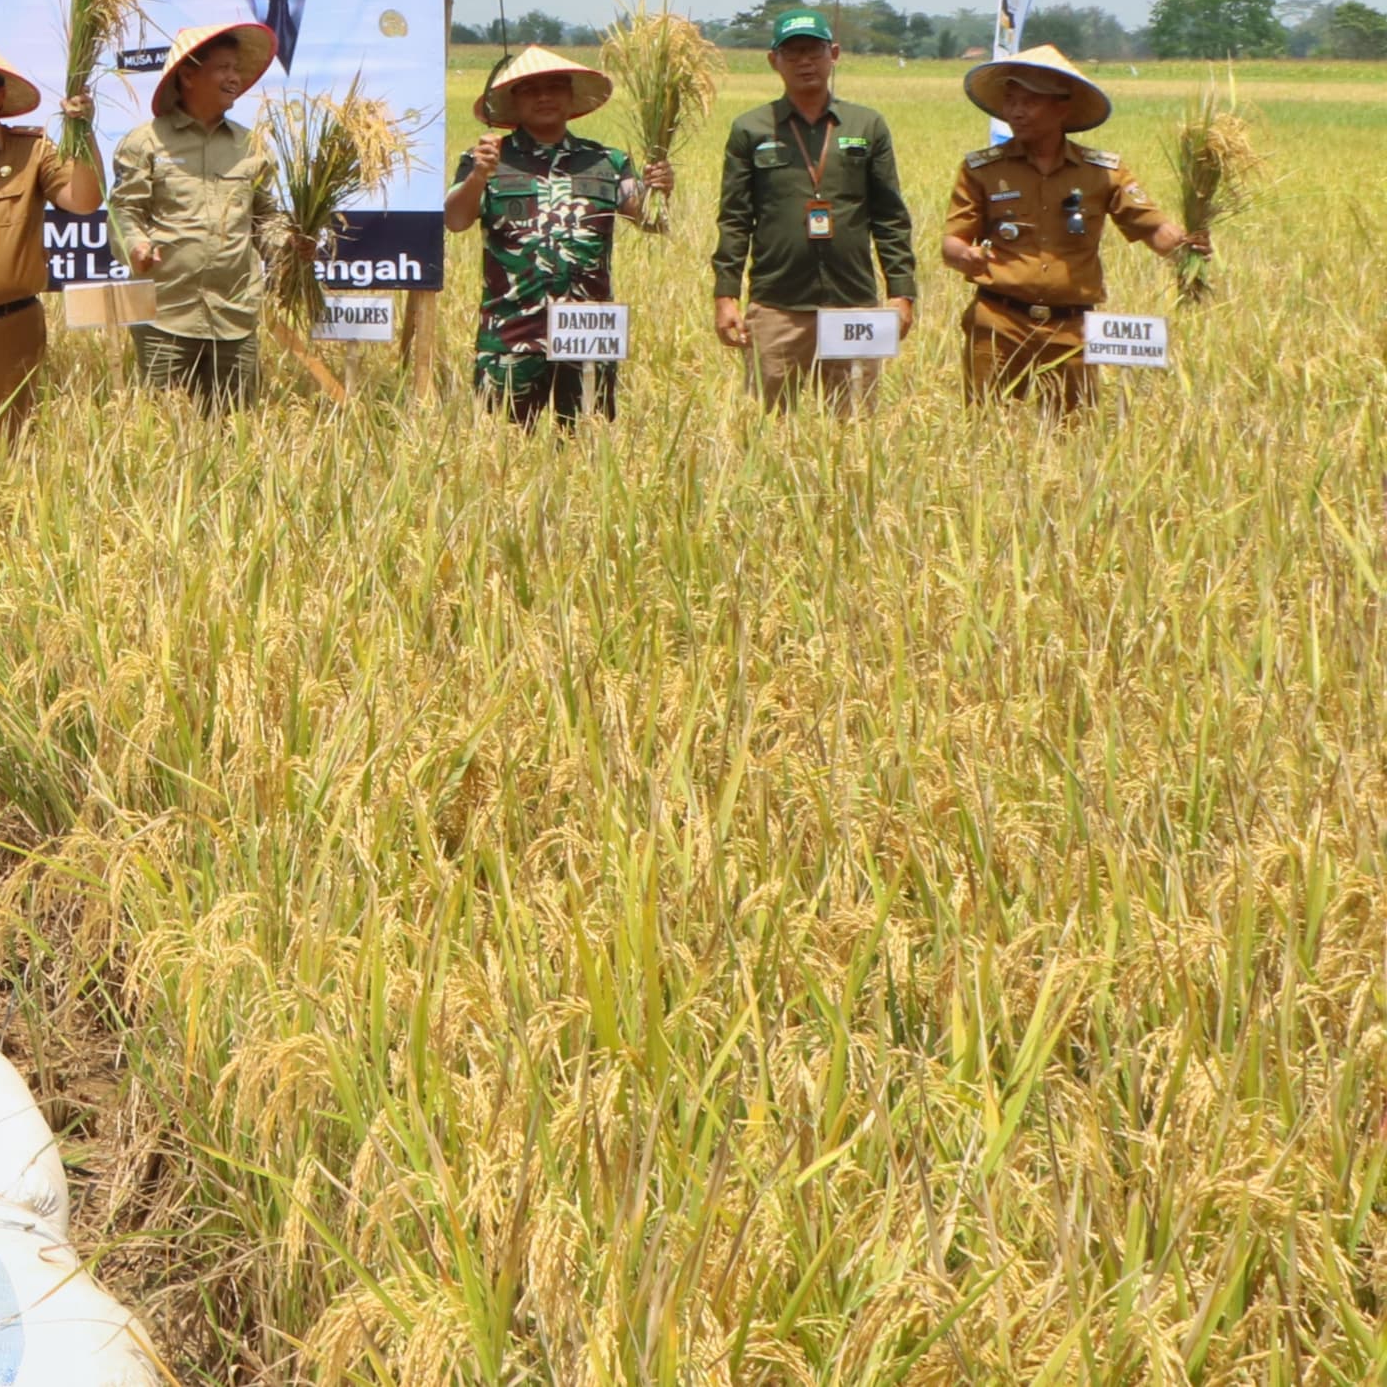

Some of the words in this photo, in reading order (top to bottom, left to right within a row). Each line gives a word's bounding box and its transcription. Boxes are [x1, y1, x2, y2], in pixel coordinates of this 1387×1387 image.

[124, 54, 153, 67] MUSA
[43, 222, 107, 248] MU
[558, 312, 616, 330] DANDIM
[1103, 320, 1153, 340] CAMAT
[843, 323, 874, 341] BPS
[553, 336, 620, 354] 0411/KM
[1089, 342, 1128, 355] SEPUTIH
[1130, 344, 1164, 357] RAMAN
